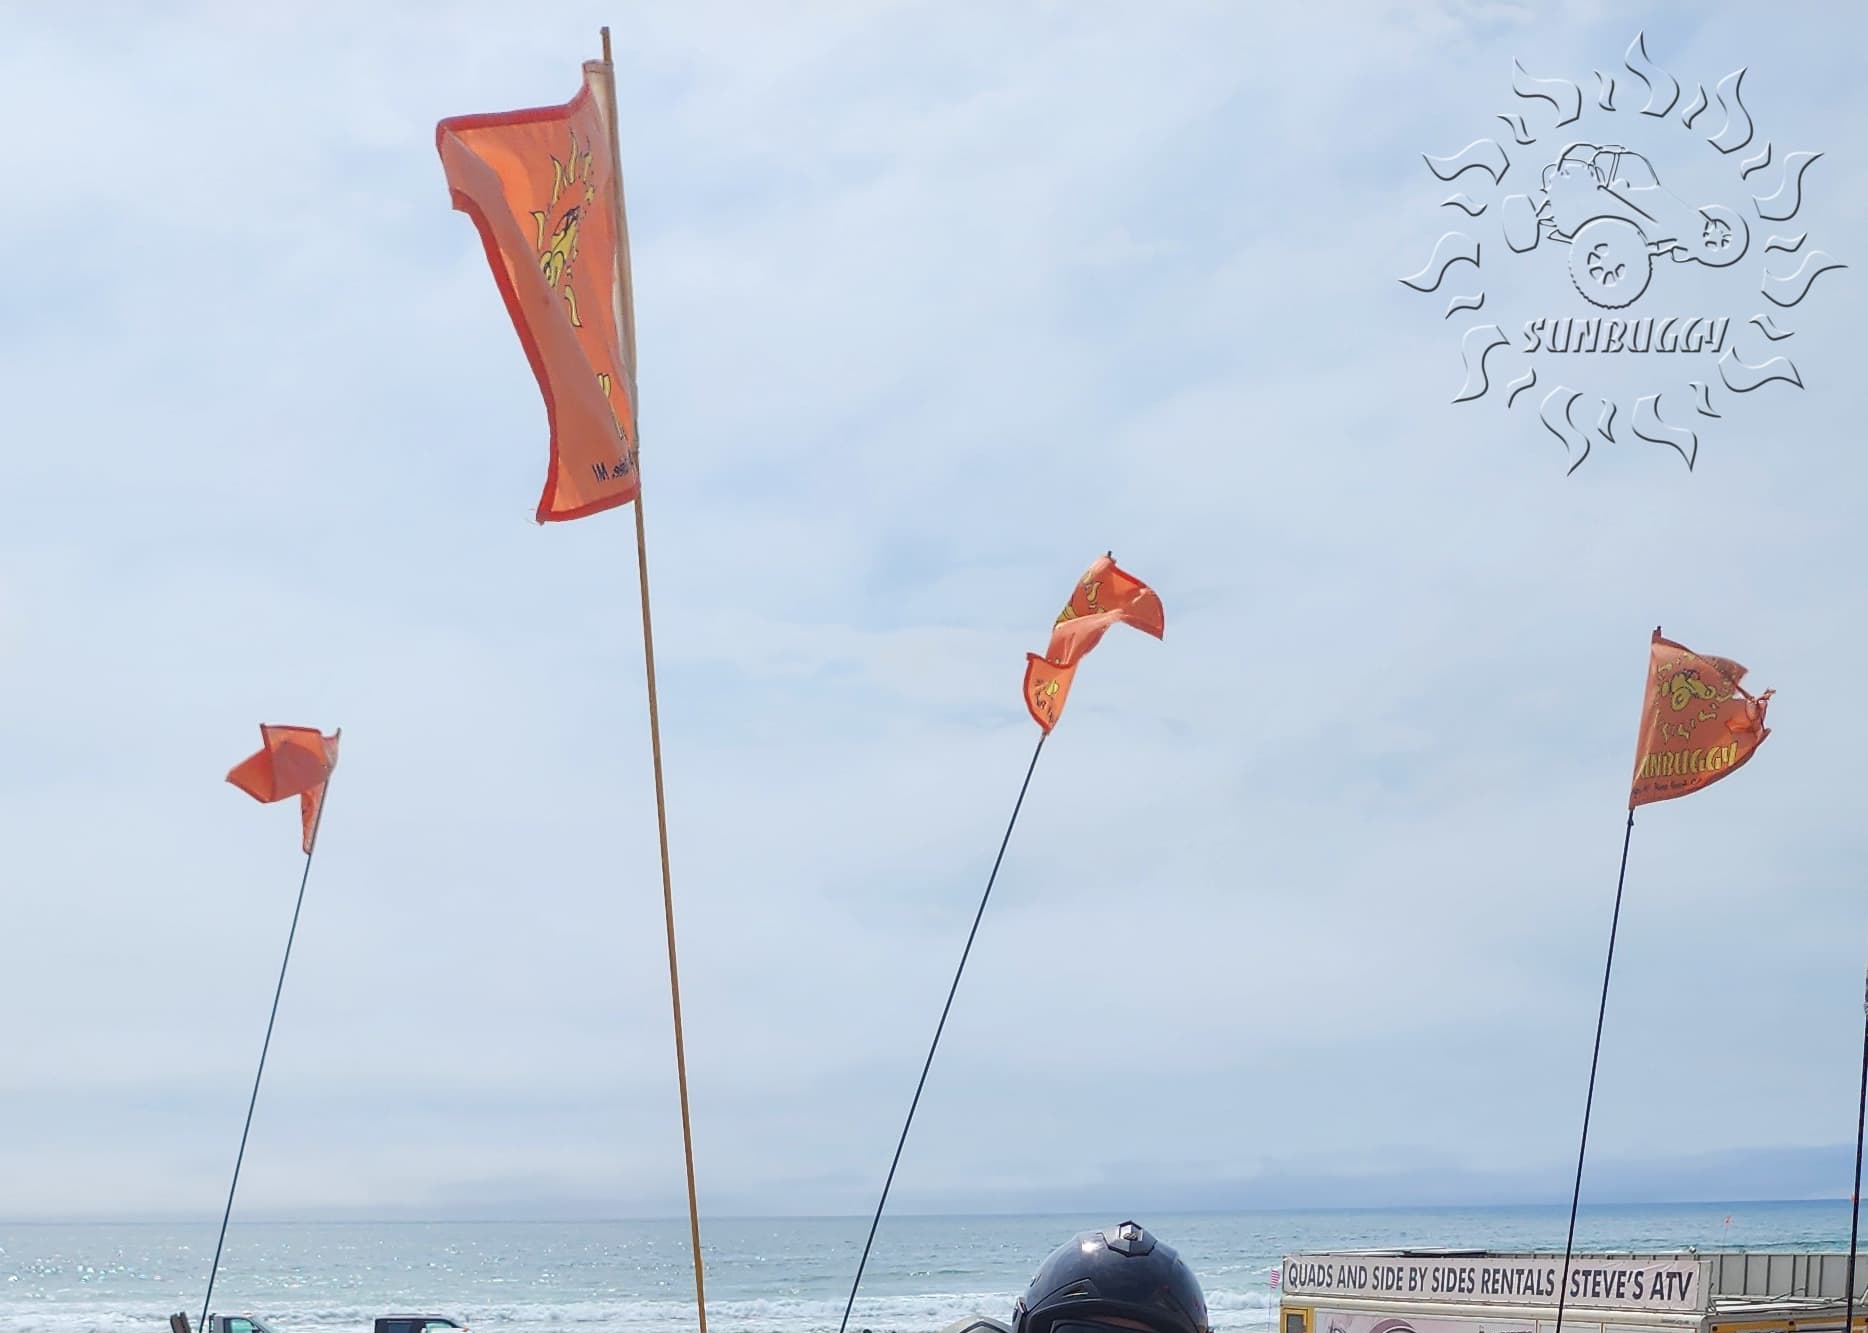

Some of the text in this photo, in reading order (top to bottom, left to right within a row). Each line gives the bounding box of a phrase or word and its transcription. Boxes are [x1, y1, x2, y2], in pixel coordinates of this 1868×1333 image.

[1288, 1262, 1694, 1302] QUADS AND SIDE BY SIDES RENTALS STEVE'S ATV
